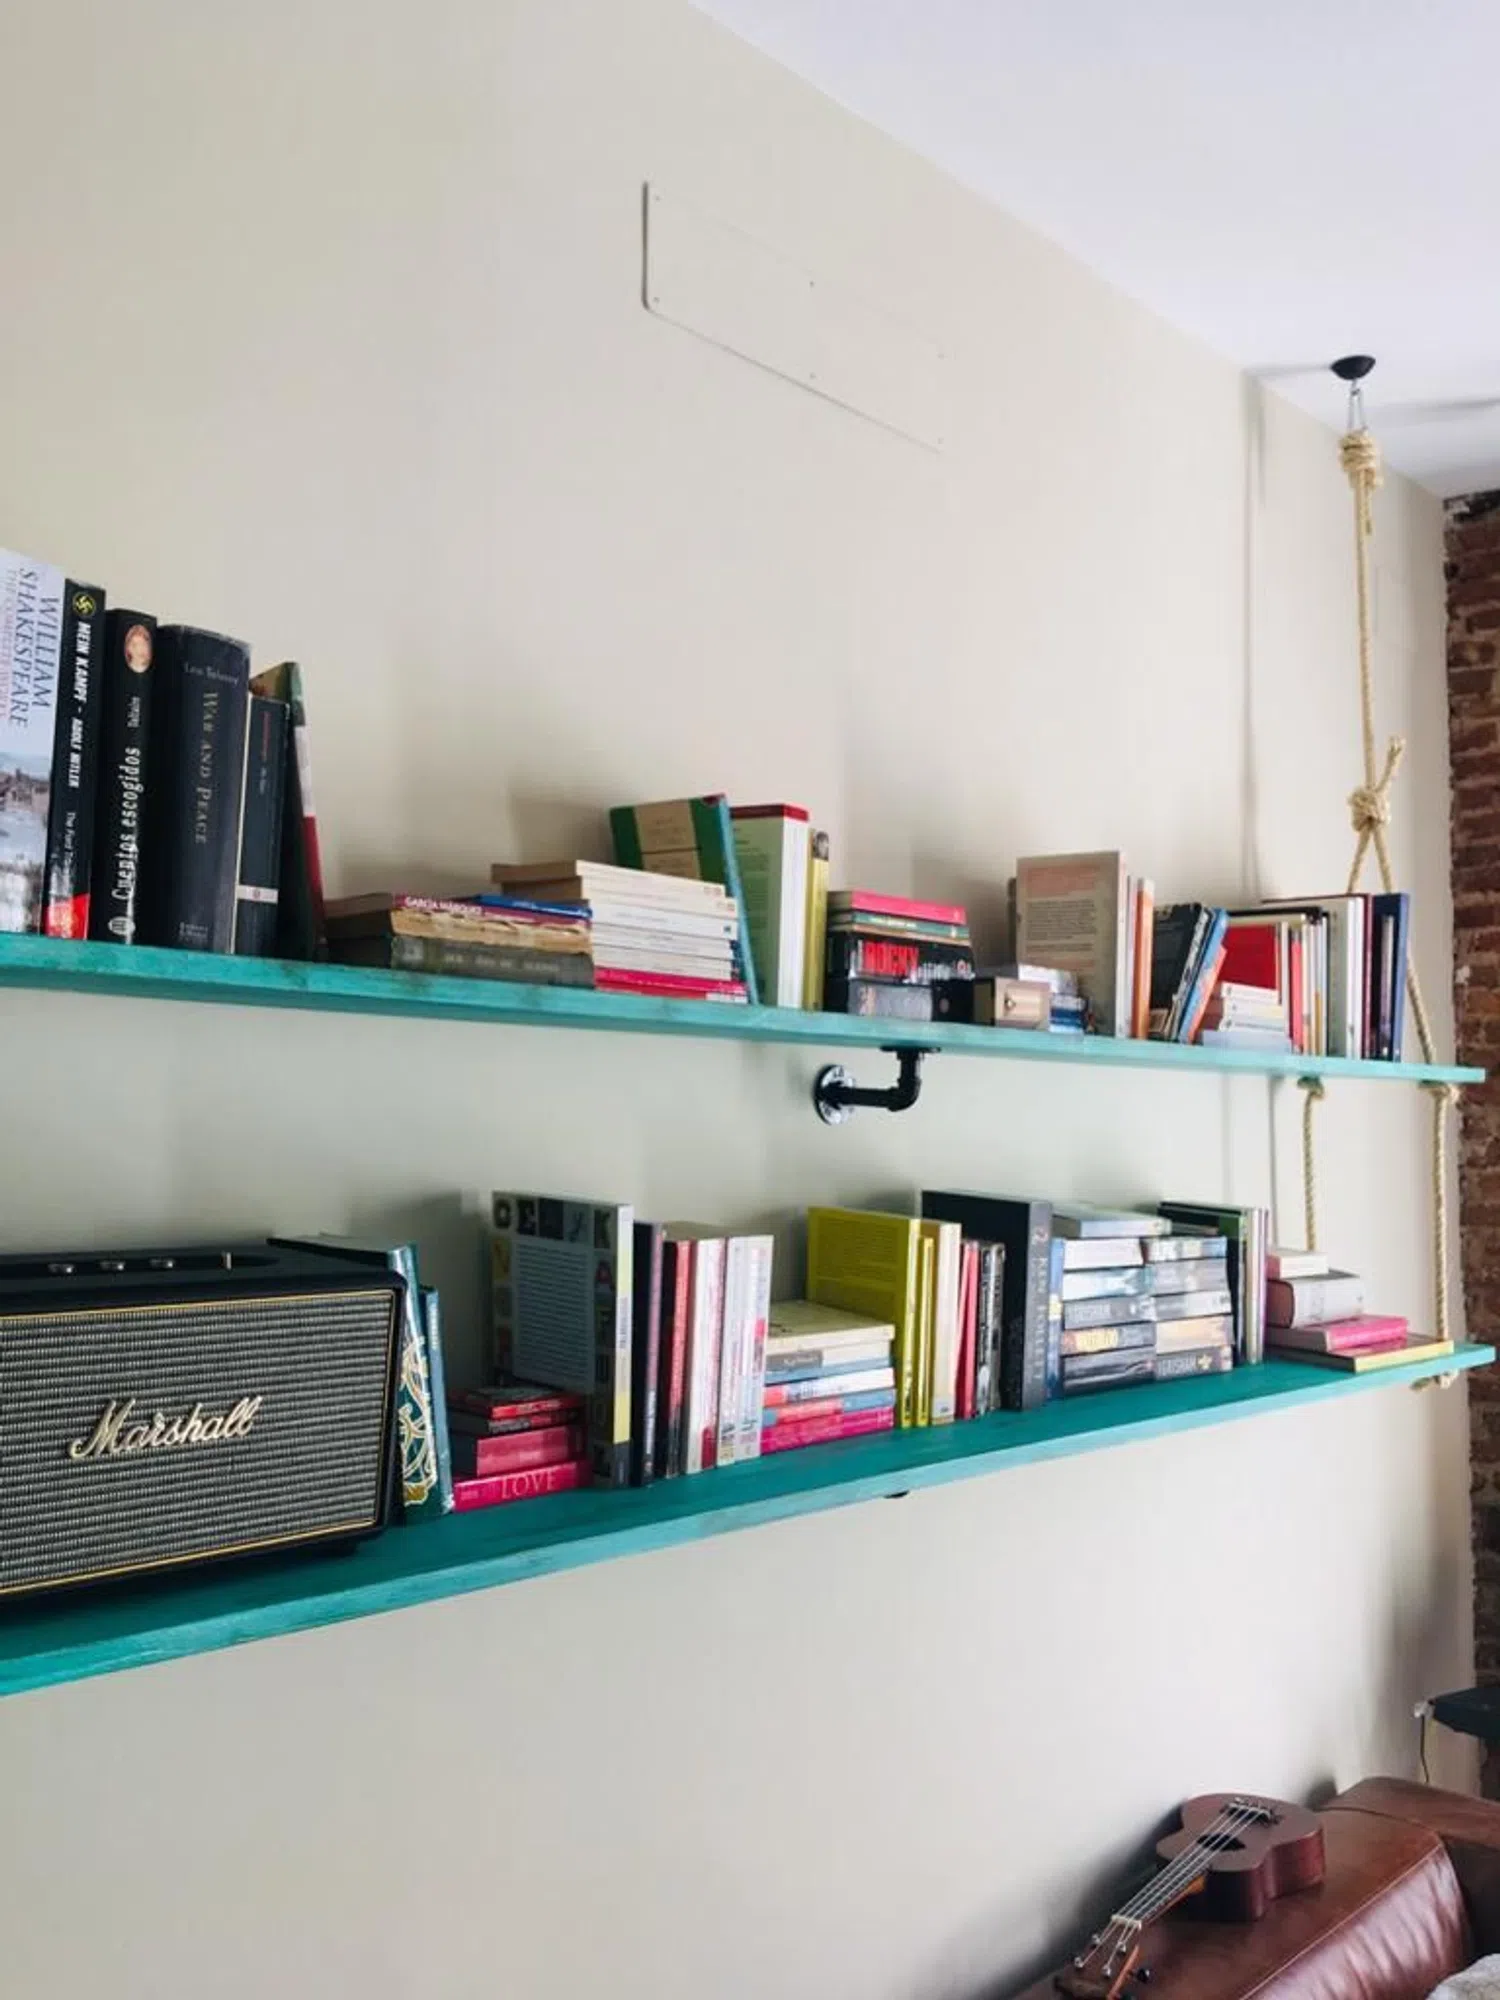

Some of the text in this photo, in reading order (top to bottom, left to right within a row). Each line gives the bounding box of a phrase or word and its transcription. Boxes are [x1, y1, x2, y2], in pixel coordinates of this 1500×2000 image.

[10, 568, 38, 729] SHAKESPEARE
[32, 598, 59, 708] WILLIAM
[76, 621, 91, 655] MEIN
[73, 656, 89, 702] KAMPF
[70, 717, 83, 750] ADOLF
[195, 692, 218, 845] WAR AND PEACE
[111, 747, 144, 900] Cuentos escogidos
[70, 1395, 264, 1459] Marshall
[501, 1470, 557, 1500] LOVE
